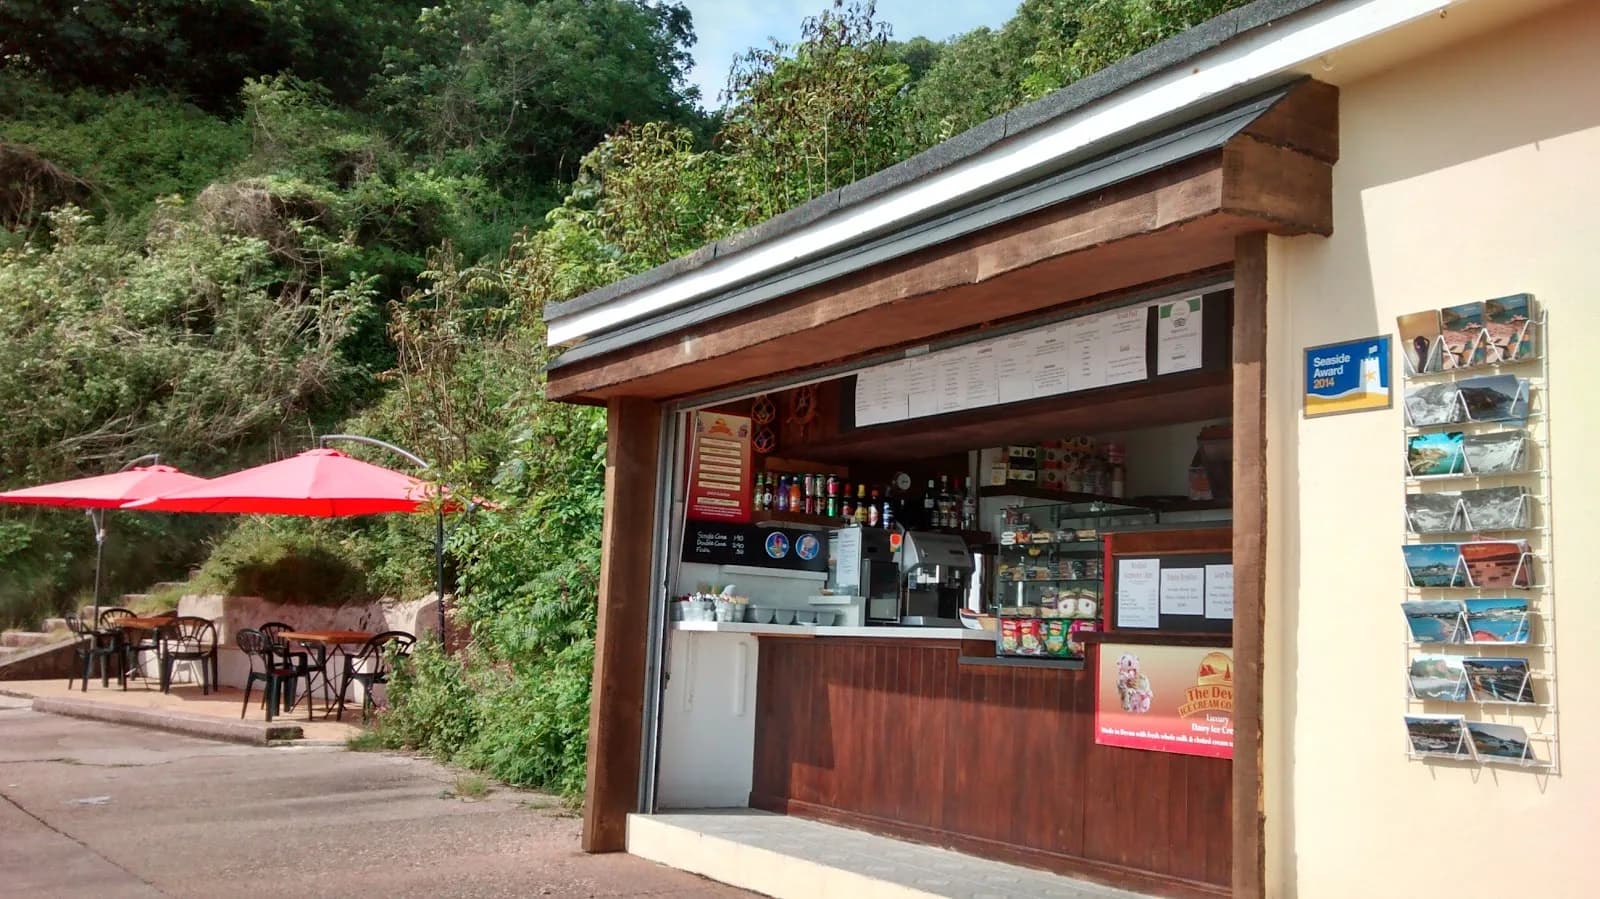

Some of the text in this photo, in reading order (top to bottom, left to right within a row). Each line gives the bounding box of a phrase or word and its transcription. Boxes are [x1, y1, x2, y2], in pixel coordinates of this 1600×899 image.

[1313, 353, 1351, 367] Seaside
[1313, 365, 1344, 378] Award
[1313, 378, 1335, 389] 2014
[1188, 688, 1209, 701] The
[1180, 704, 1192, 716] ICE
[1193, 700, 1219, 710] CREAM
[1206, 713, 1229, 728] Luxury
[1191, 723, 1210, 735] Dairy
[1210, 725, 1220, 733] Ice
